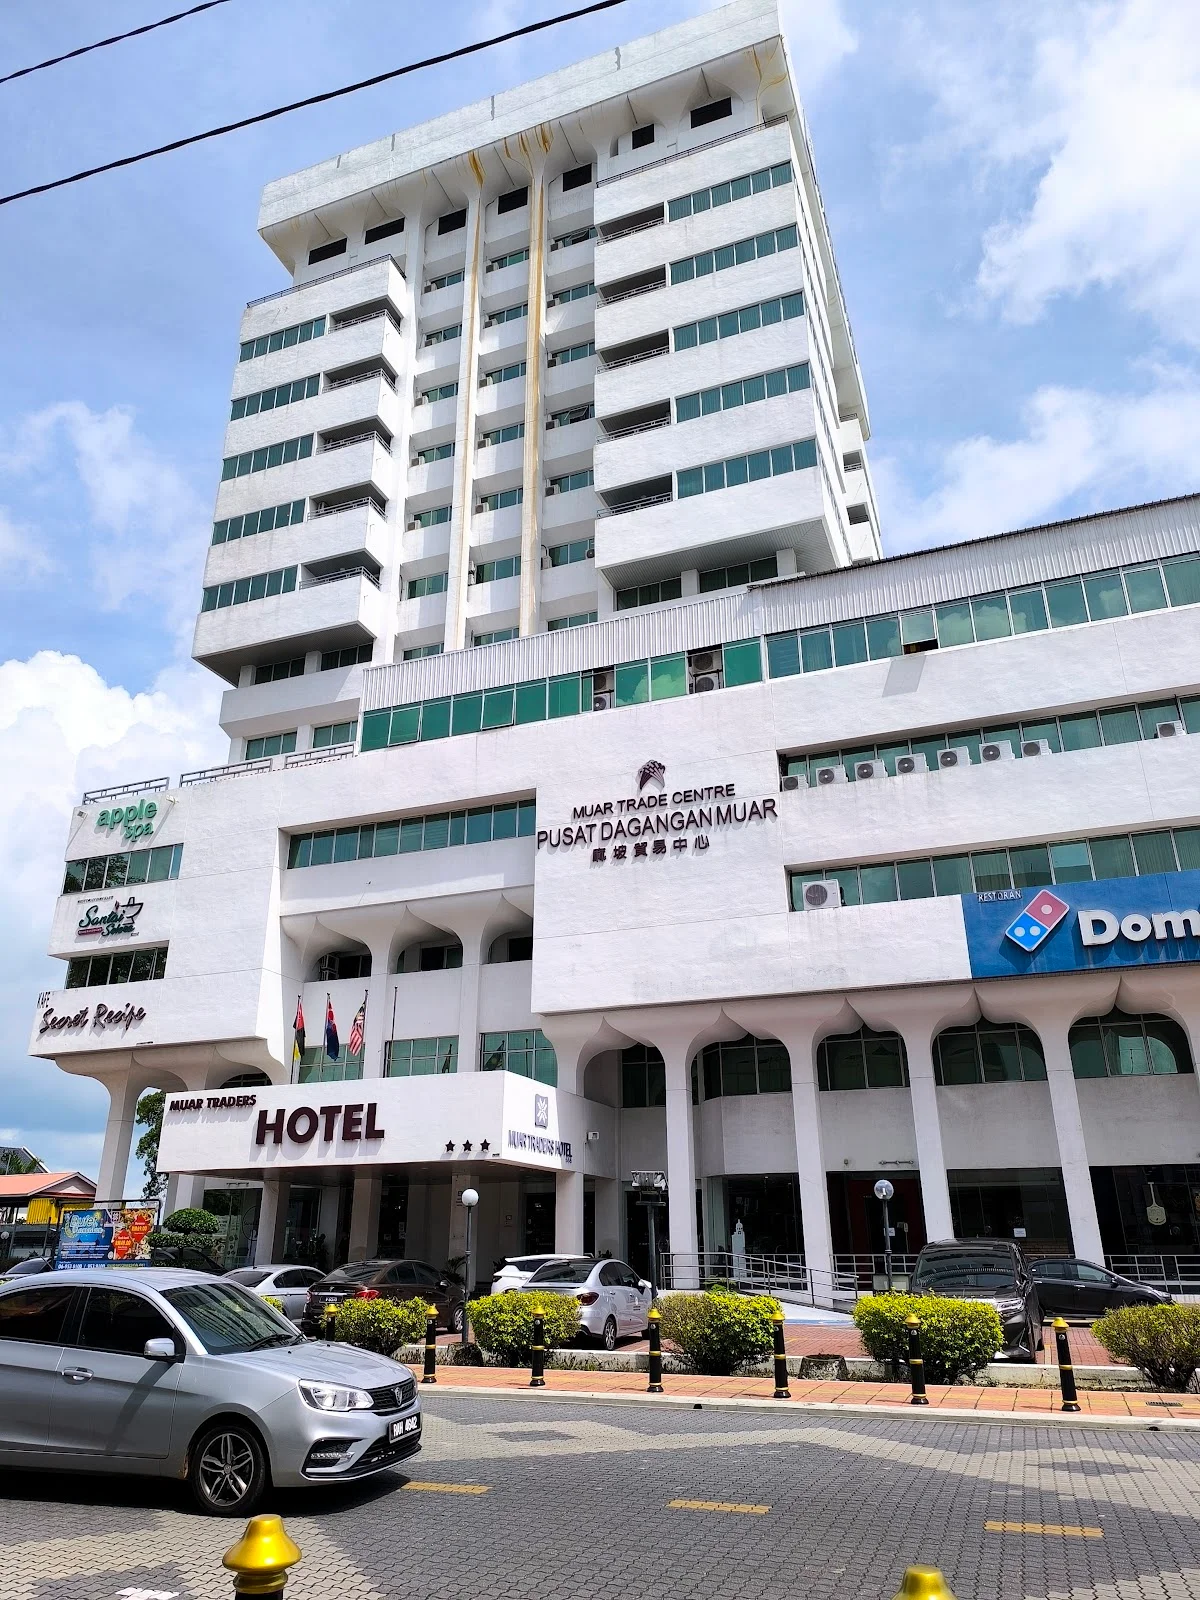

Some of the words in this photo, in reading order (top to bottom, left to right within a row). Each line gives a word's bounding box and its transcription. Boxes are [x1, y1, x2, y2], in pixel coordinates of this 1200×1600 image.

[96, 799, 157, 829] apple
[573, 801, 614, 819] MUAR
[617, 794, 668, 815] TRADE
[672, 783, 736, 805] CENTRE
[125, 822, 154, 842] spa
[537, 823, 597, 849] PUSAT
[600, 807, 713, 841] DAGANGAN
[716, 798, 778, 825] MUAR
[978, 890, 1021, 902] RESTORAN
[40, 1007, 89, 1033] Secret
[93, 1002, 147, 1030] Recipe
[169, 1098, 204, 1111] MUAR
[206, 1094, 257, 1109] TRADERS
[255, 1102, 385, 1145] HOTEL
[554, 1140, 572, 1158] HOTEL
